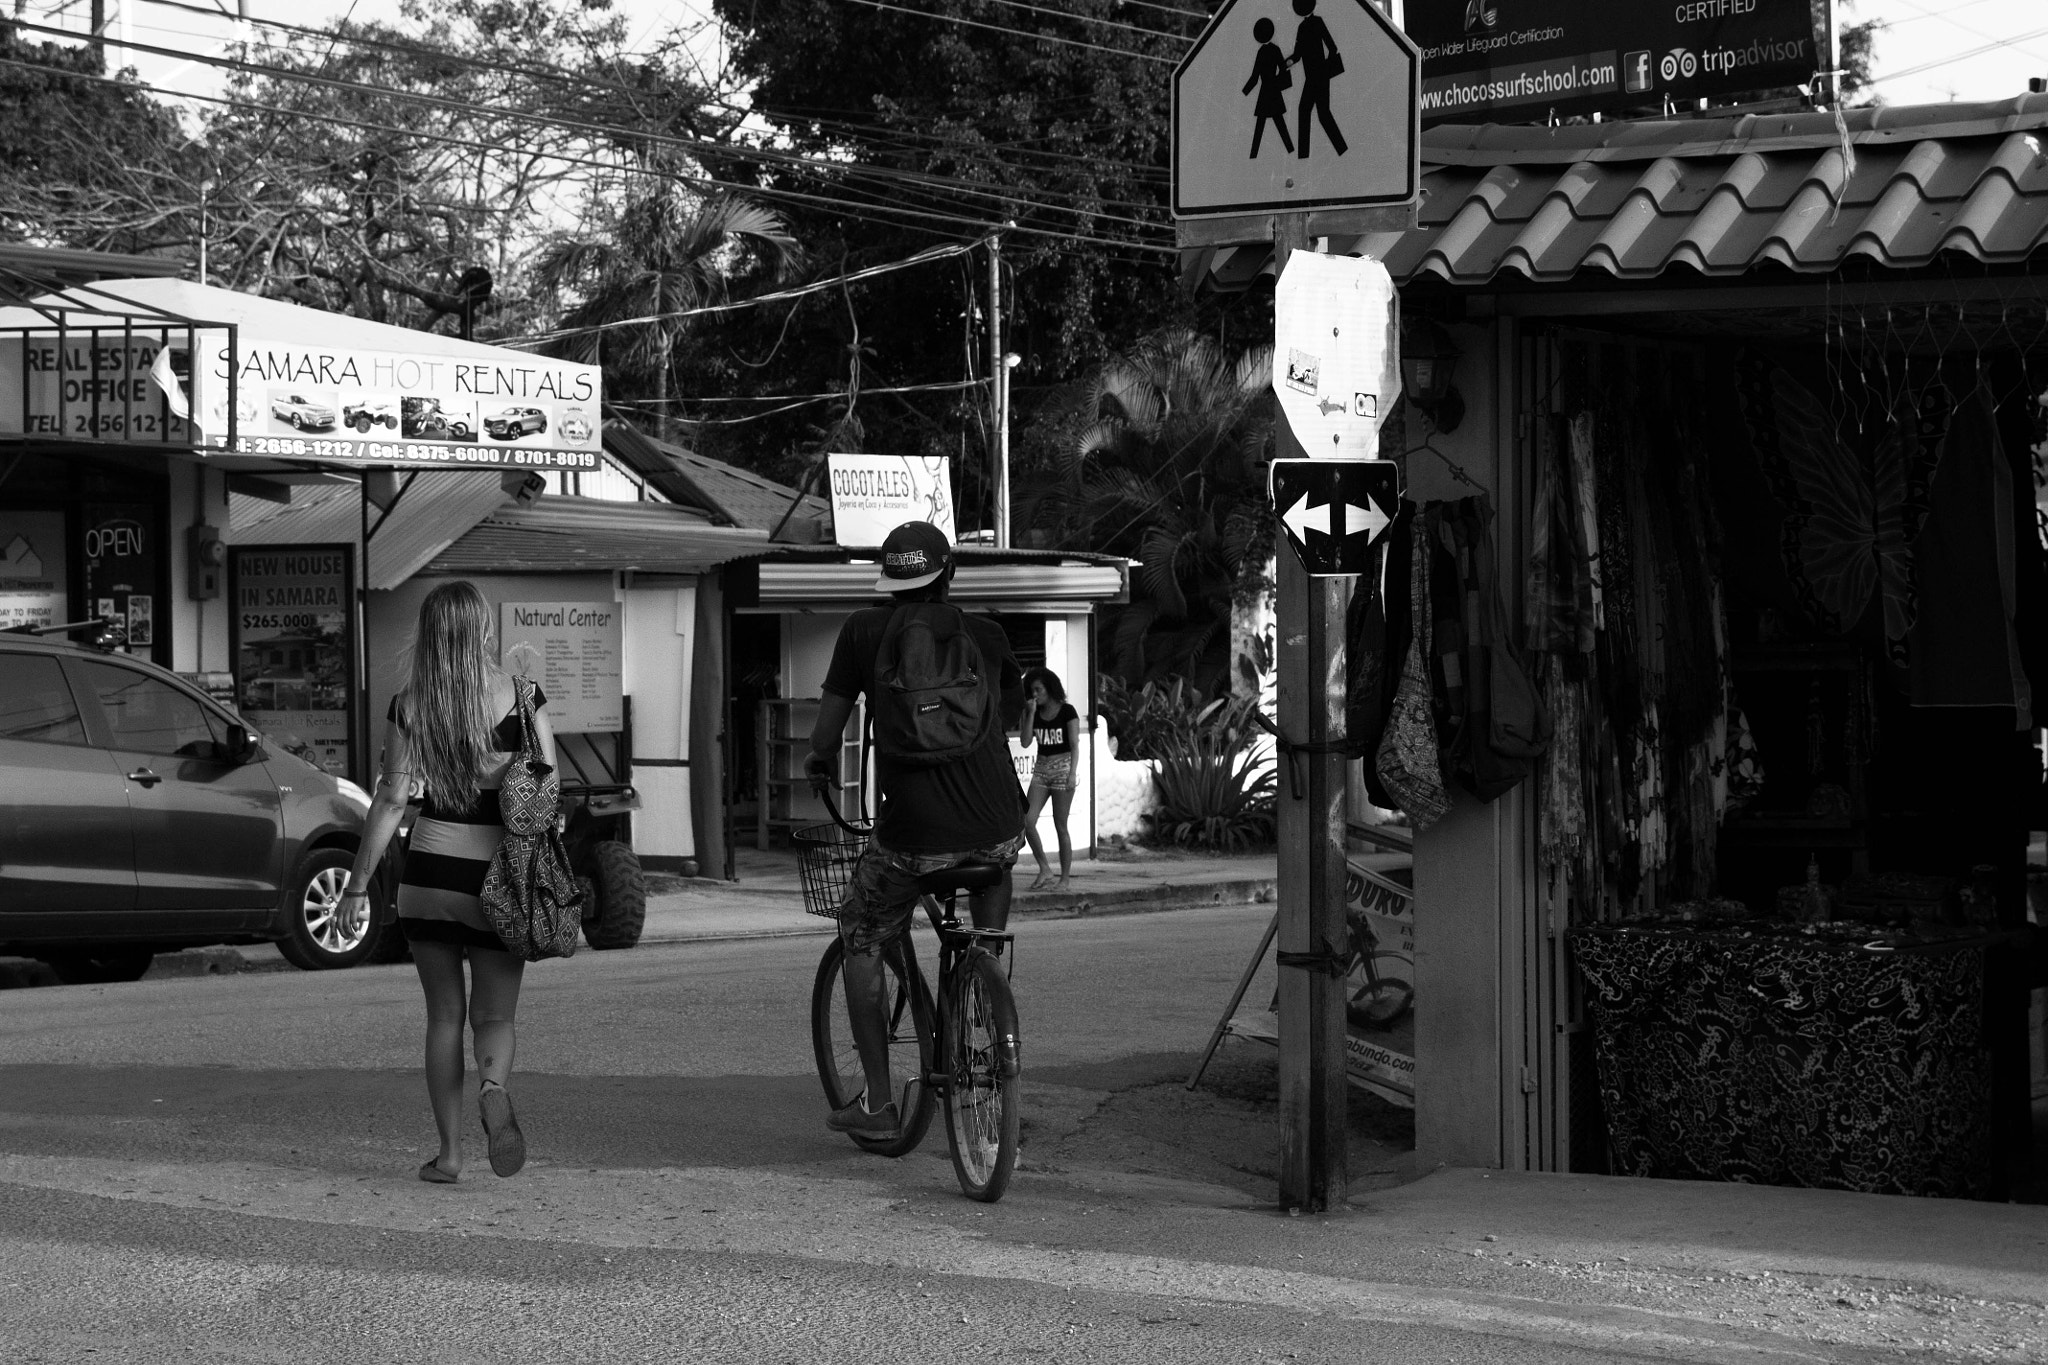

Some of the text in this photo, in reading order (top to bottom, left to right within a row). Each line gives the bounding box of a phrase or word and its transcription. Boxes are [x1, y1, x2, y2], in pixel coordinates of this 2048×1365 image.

[1675, 0, 1756, 24] CERTIFIED
[1441, 41, 1465, 56] Water
[1467, 33, 1508, 53] Lifeguard
[1510, 25, 1564, 45] Certification
[1701, 39, 1804, 76] tripadvisor
[27, 347, 161, 371] REAL ESTA
[214, 347, 593, 402] SAMARA HOT RENTALS
[254, 437, 353, 458] 2656-1212
[406, 444, 500, 463] 8375-6000
[514, 450, 596, 468] 8701-8019
[833, 468, 909, 498] COCOTALES
[86, 527, 142, 558] OPEN
[241, 556, 343, 576] NEW HOUSE
[242, 586, 338, 606] IN SAMARA
[27, 607, 52, 617] FRIDAY
[243, 614, 309, 629] $265.000
[514, 606, 612, 627] Natural Center
[306, 713, 342, 727] Rentals
[1346, 873, 1406, 916] DURO
